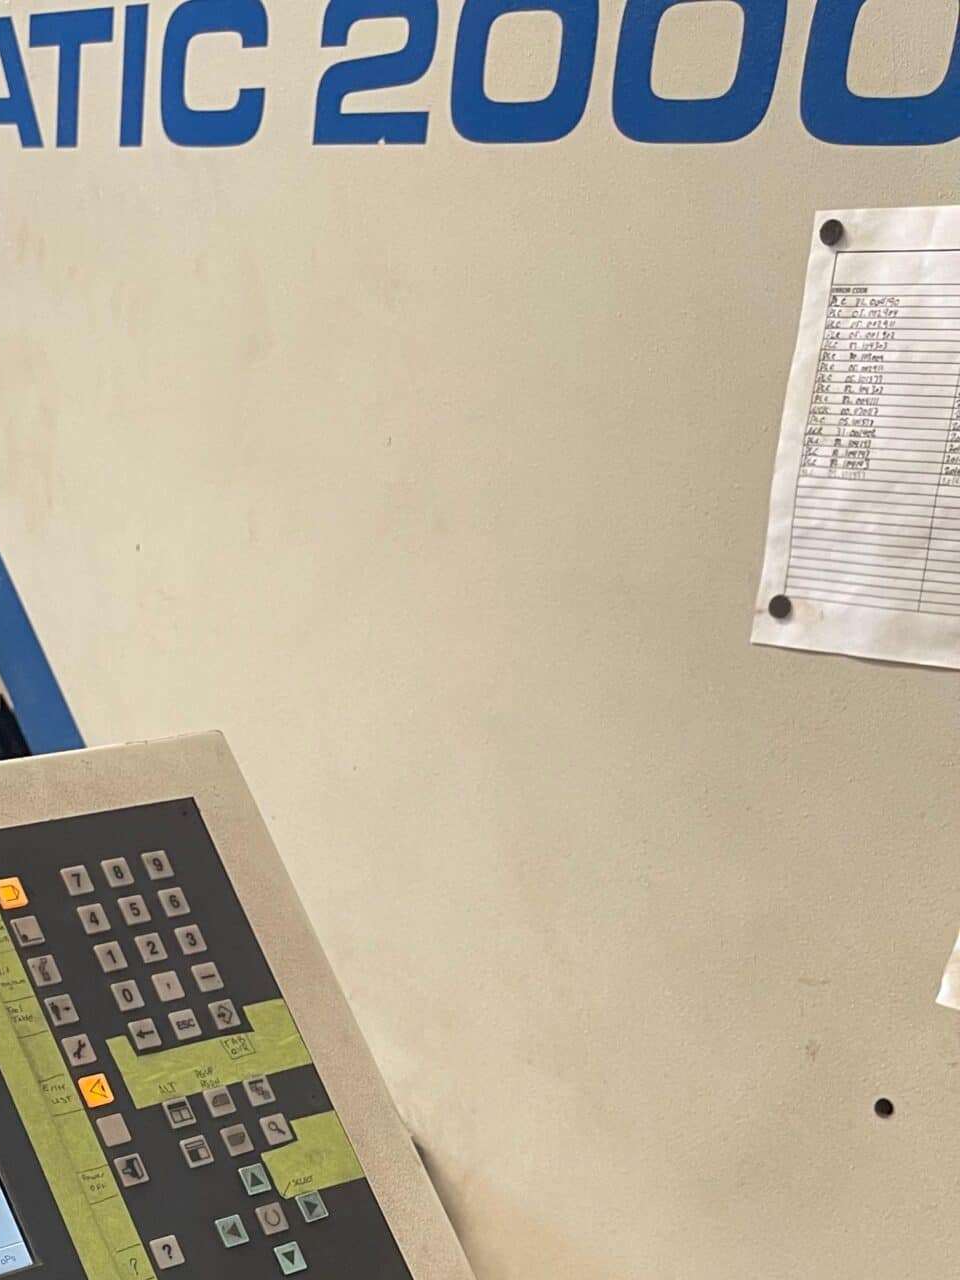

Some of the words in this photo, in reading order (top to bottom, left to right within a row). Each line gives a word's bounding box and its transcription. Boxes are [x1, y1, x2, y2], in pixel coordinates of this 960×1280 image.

[152, 857, 164, 872] 9
[112, 865, 124, 880] 8
[71, 873, 82, 888] 7
[169, 894, 180, 909] 6
[129, 902, 141, 917] 5
[89, 911, 100, 926] 4
[185, 932, 197, 947] 3
[146, 940, 159, 956] 2
[106, 949, 117, 965] 1
[122, 988, 134, 1004] 0
[175, 1017, 197, 1031] ESC
